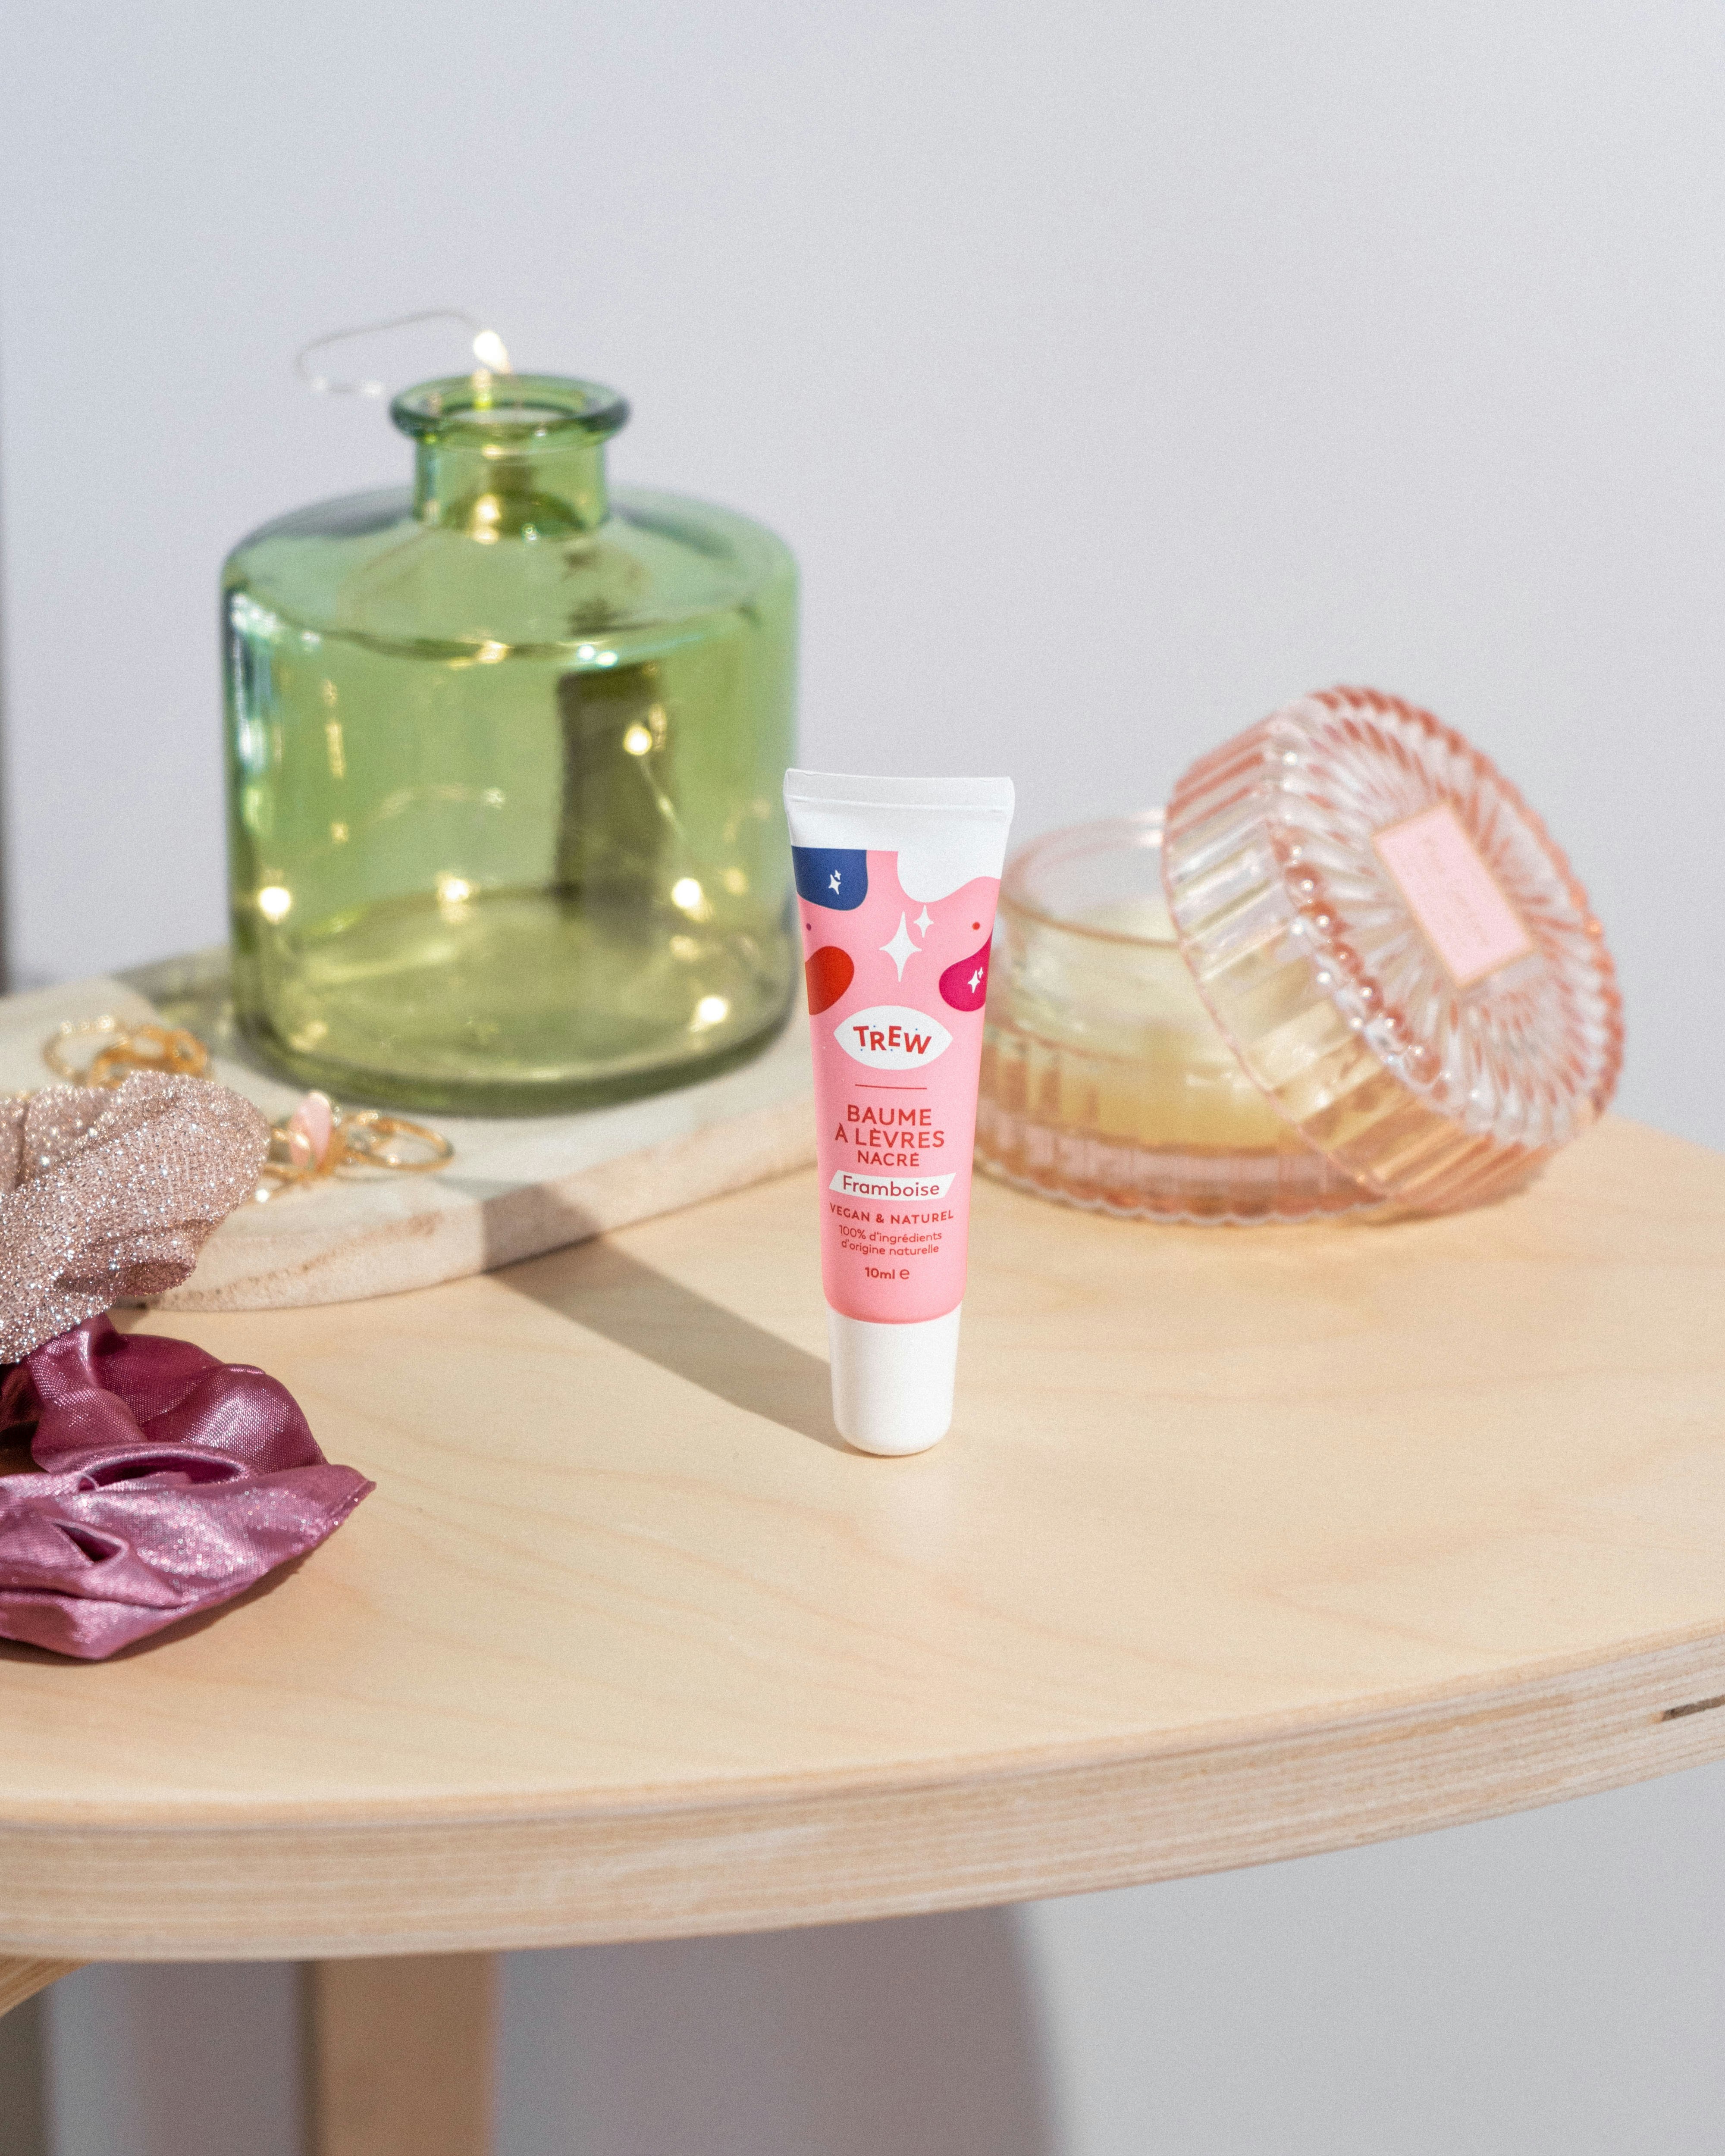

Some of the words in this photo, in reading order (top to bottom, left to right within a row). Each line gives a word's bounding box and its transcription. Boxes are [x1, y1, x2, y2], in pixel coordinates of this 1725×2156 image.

[853, 1026, 932, 1055] TREW
[847, 1104, 931, 1126] BAUME
[835, 1122, 848, 1143] À
[856, 1128, 944, 1148] LÈVRES
[858, 1150, 919, 1166] NACRÉ
[843, 1175, 939, 1197] Framboise
[830, 1203, 869, 1222] VEGAN
[876, 1214, 884, 1223] &
[891, 1210, 953, 1224] NATUREL
[839, 1225, 866, 1239] 100%
[870, 1232, 942, 1244] d'ingrédients
[842, 1239, 885, 1254] d'origine
[890, 1244, 939, 1255] naturelle
[865, 1267, 895, 1279] 10ml
